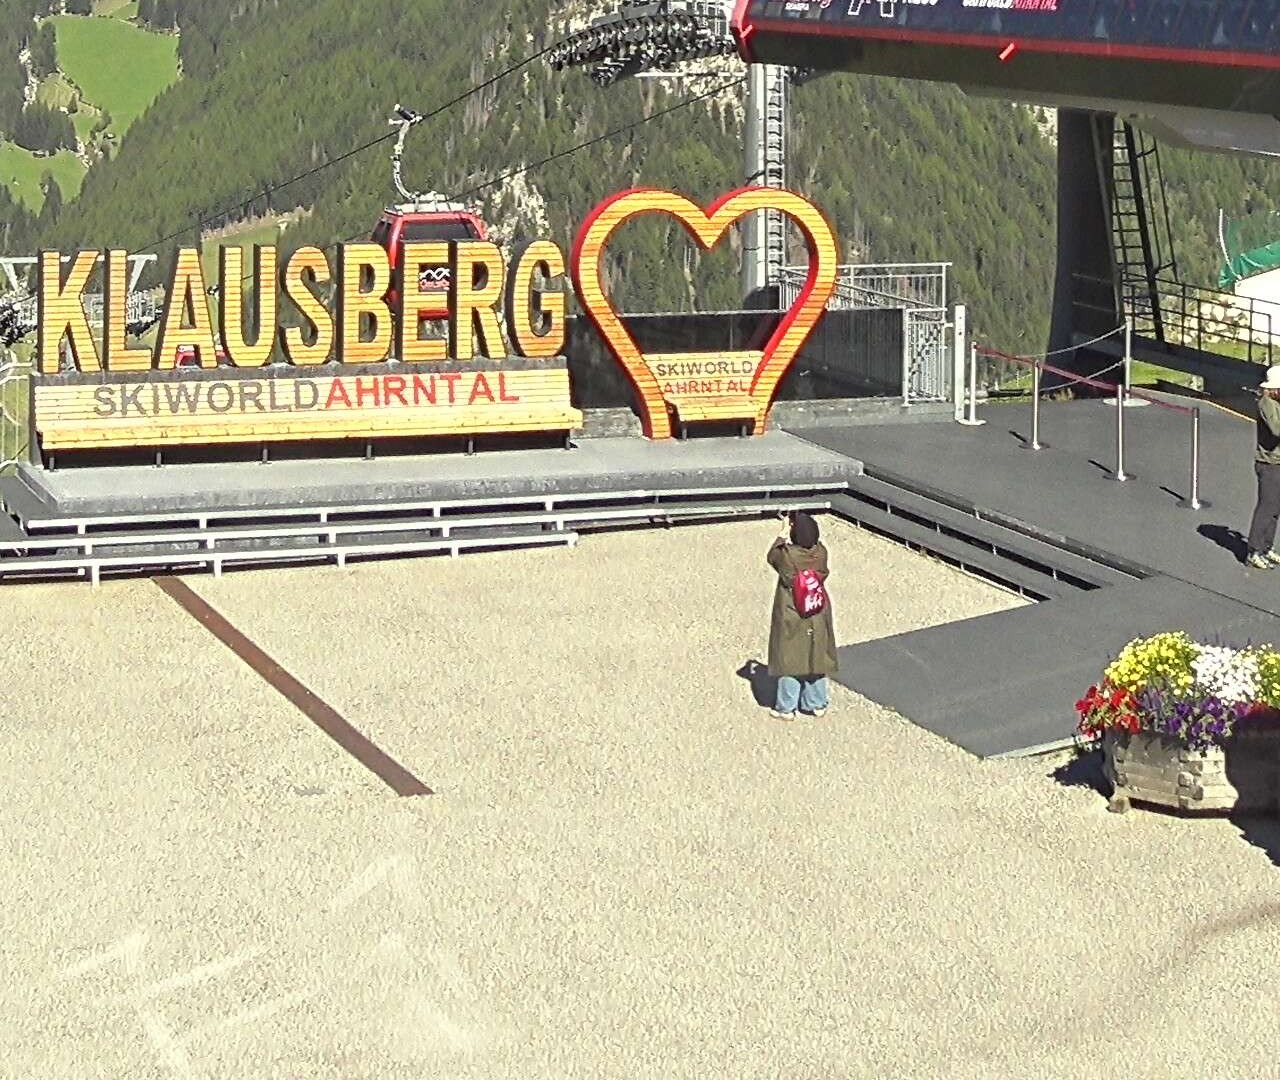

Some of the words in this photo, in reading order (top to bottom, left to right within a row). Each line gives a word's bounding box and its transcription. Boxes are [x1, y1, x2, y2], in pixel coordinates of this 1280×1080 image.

[38, 240, 568, 373] KLAUSBERG
[655, 360, 754, 377] SKIWORLD
[663, 378, 751, 395] AHRNTAL
